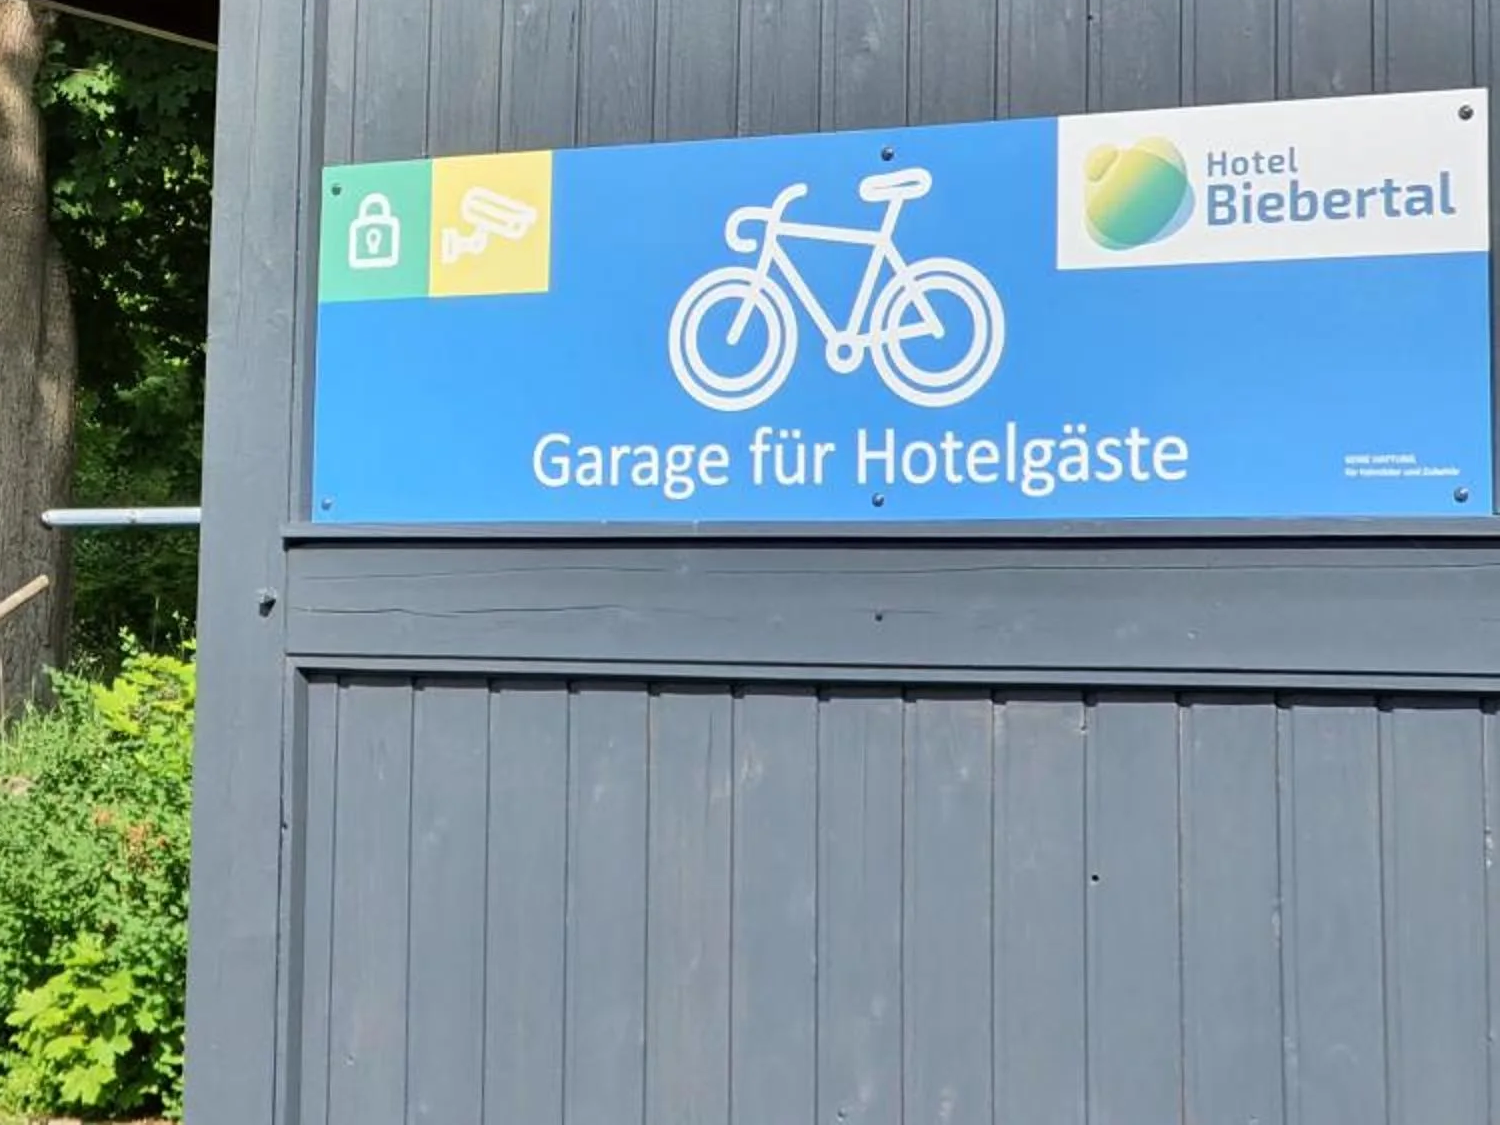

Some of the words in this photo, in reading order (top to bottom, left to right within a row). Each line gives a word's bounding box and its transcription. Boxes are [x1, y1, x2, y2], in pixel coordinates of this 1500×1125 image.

[1206, 146, 1299, 178] Hotel
[1206, 171, 1457, 226] Biebertal
[532, 432, 731, 501] Garage
[748, 425, 836, 486] für
[856, 421, 1190, 497] Hotelgäste
